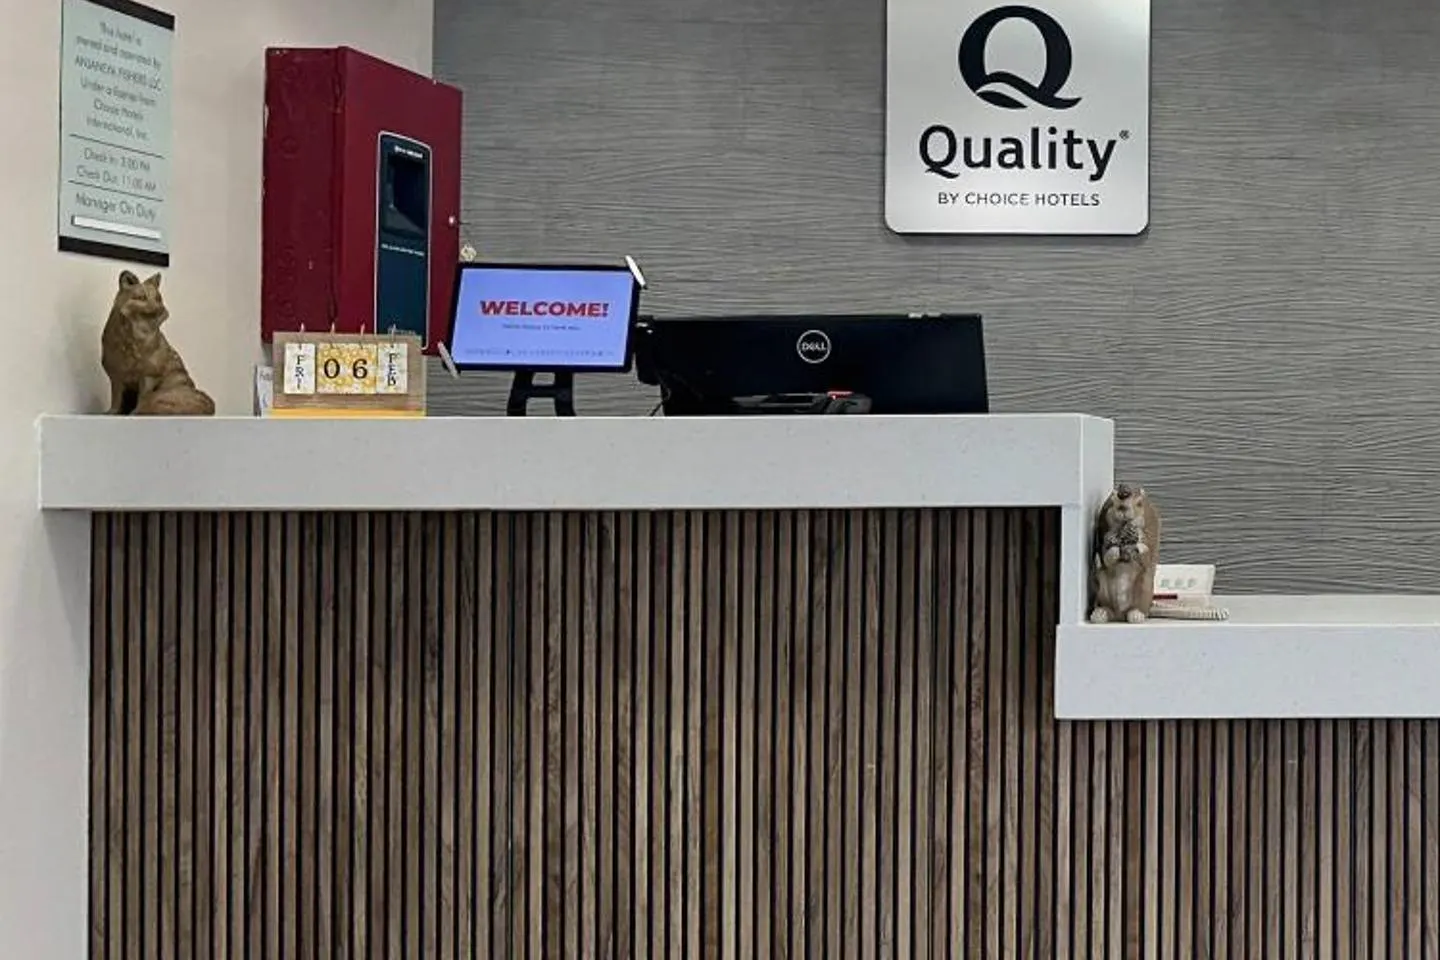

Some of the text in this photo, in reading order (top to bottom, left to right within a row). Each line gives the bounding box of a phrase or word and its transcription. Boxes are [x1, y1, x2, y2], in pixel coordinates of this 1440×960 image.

[958, 5, 1082, 109] Q
[919, 125, 1117, 181] Quality
[938, 192, 1100, 207] BY CHOICE HOTELS
[480, 300, 610, 318] WELCOME!
[802, 341, 827, 351] DELL
[295, 355, 305, 389] FRI
